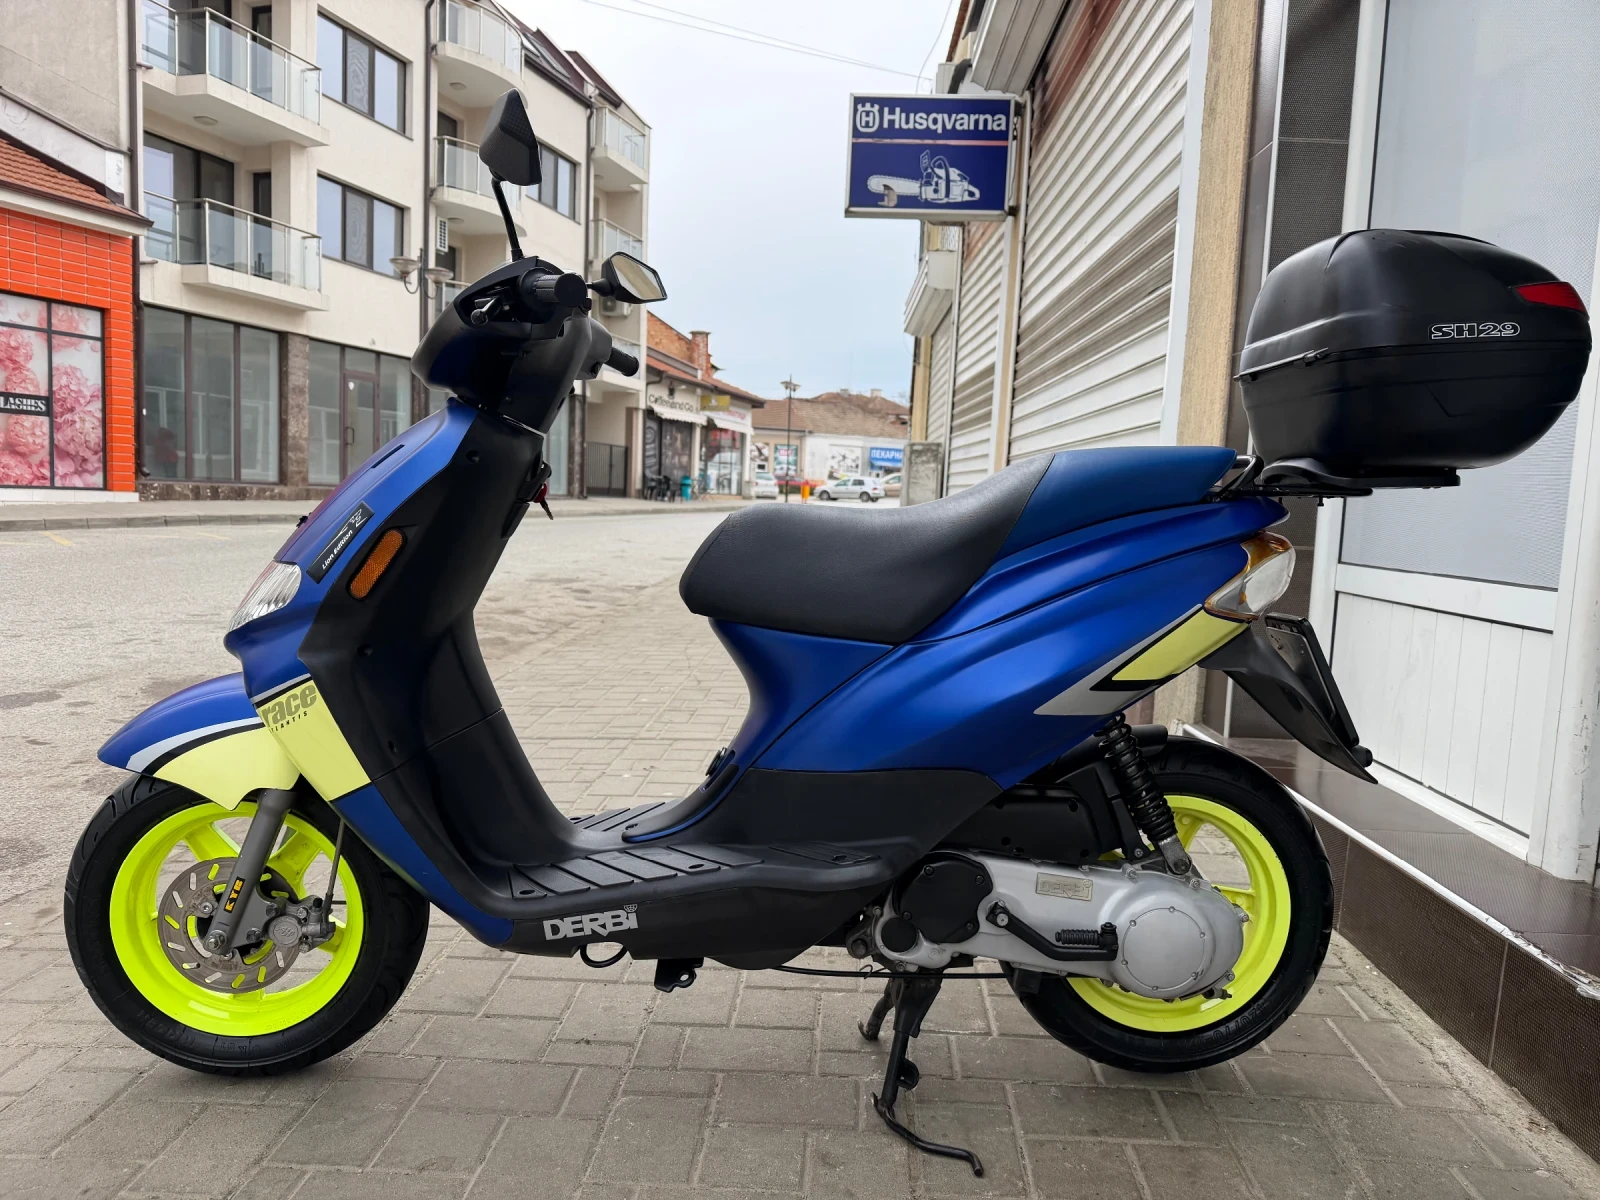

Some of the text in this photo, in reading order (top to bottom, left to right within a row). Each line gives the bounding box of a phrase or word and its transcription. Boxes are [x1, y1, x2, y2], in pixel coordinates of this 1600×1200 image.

[882, 106, 1007, 134] Husqvarna
[1431, 321, 1521, 340] SH29
[321, 529, 353, 570] Lion Edition
[261, 684, 317, 727] race
[269, 710, 308, 733] TLANTIS
